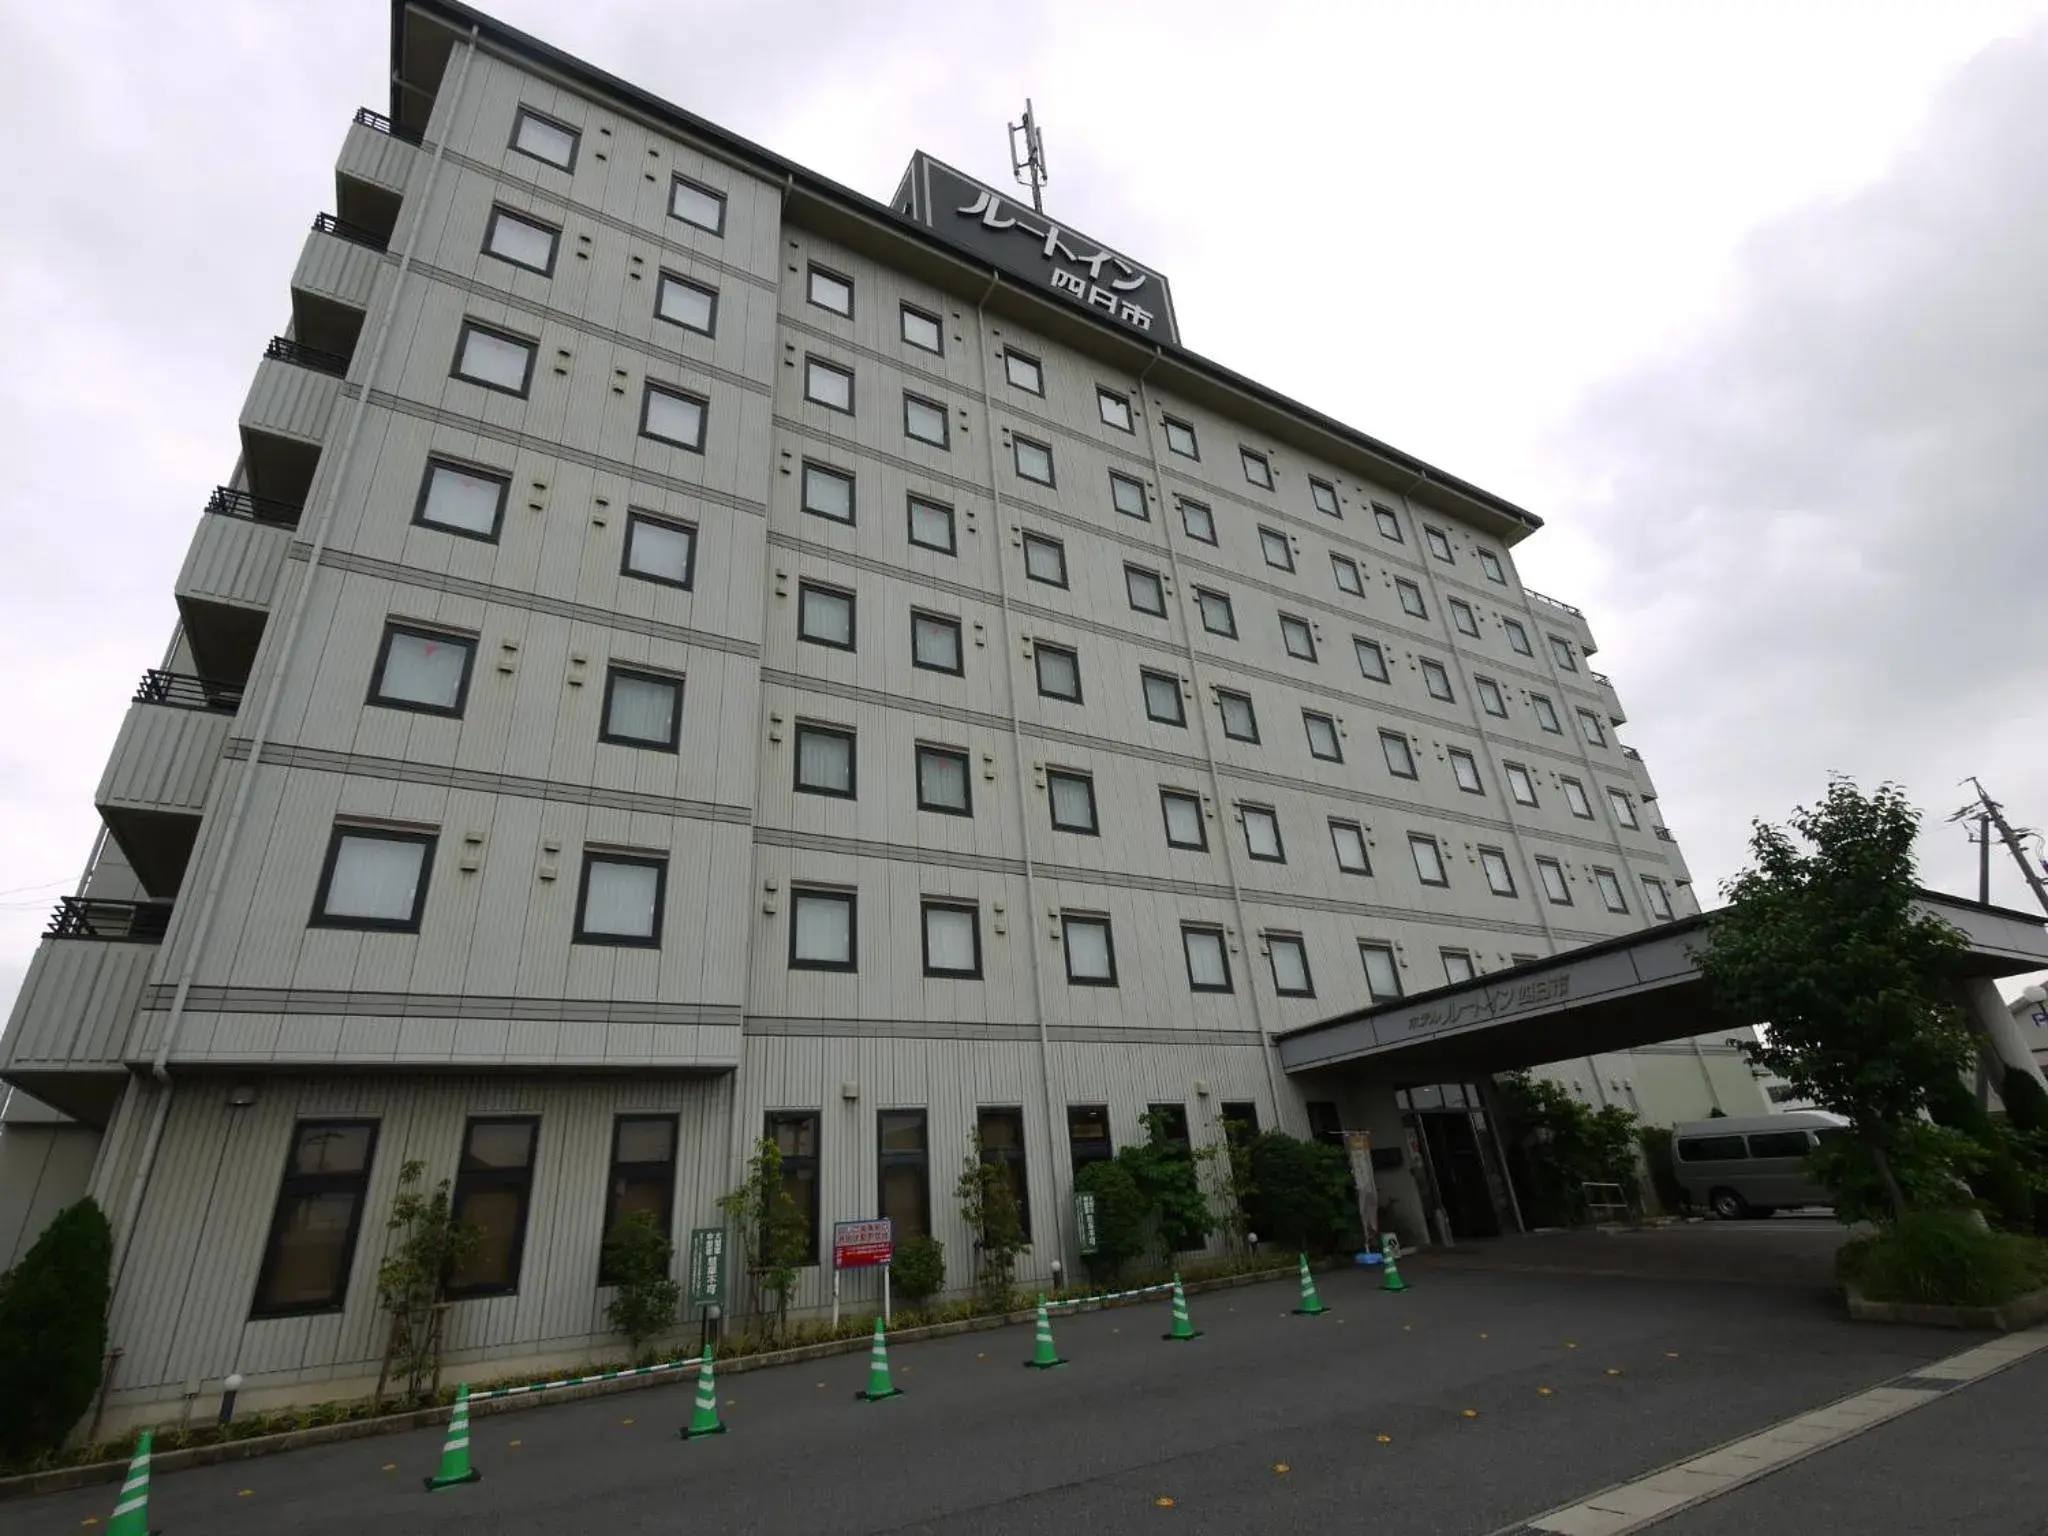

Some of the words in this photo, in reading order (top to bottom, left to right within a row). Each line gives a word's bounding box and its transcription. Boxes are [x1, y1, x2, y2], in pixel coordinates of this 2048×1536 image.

[956, 190, 1147, 291] ルートイン
[1050, 267, 1154, 331] 四日市
